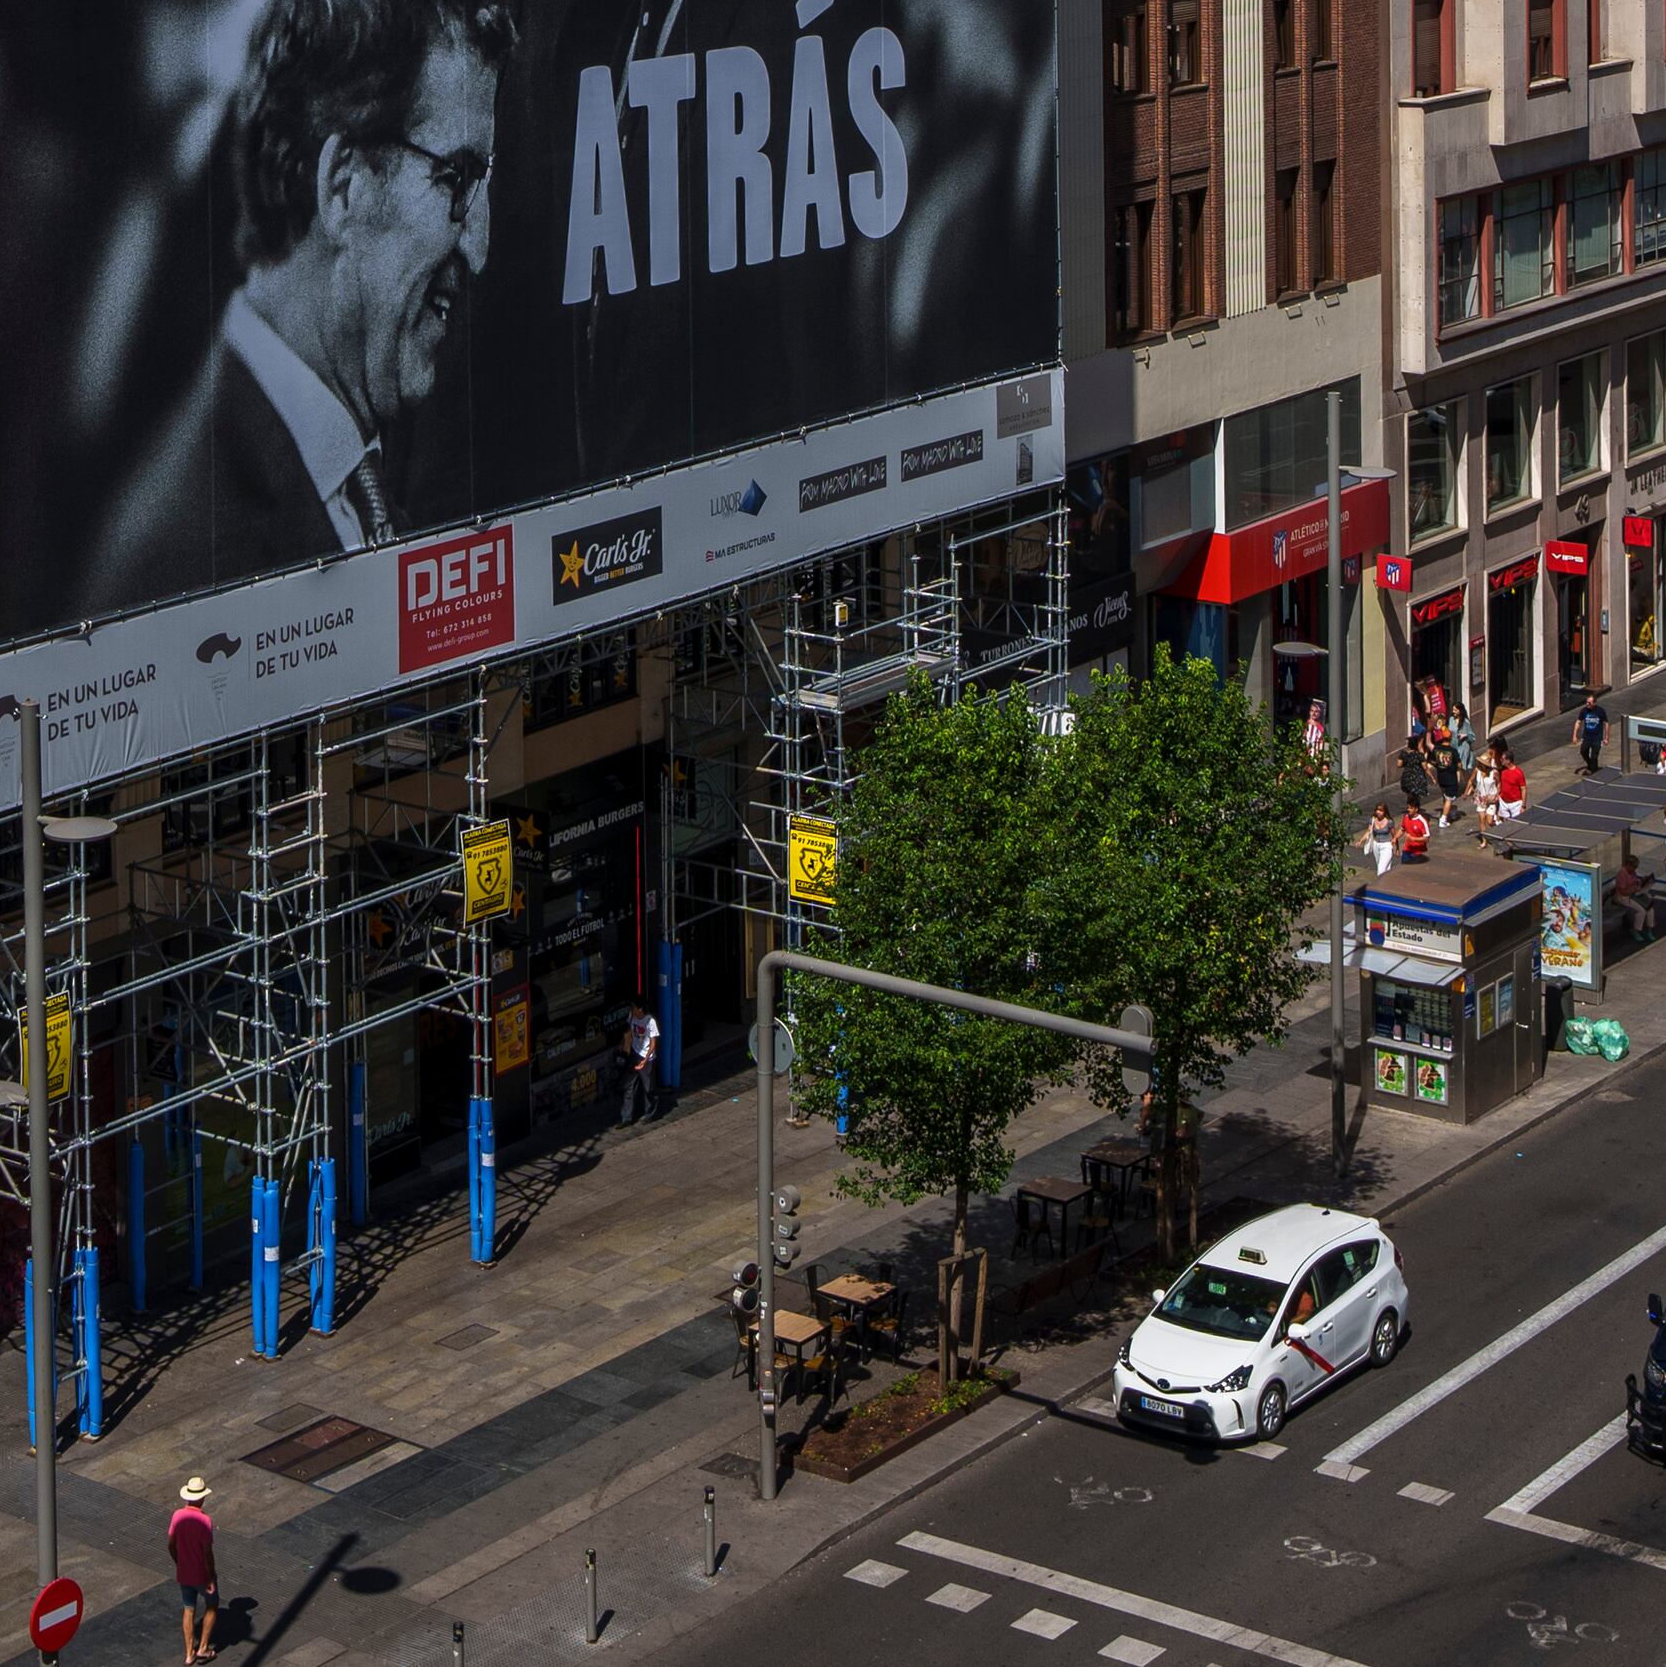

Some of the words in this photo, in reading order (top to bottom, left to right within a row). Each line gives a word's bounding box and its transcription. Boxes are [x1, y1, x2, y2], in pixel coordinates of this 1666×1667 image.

[710, 492, 741, 517] LUXOR
[800, 482, 819, 508] FROM
[821, 472, 848, 503] MADRID
[1290, 521, 1319, 542] ATLÉTICO
[1325, 510, 1350, 530] MRID
[584, 536, 627, 576] Carl's
[727, 532, 776, 556] ESTRUCTURAS
[1551, 551, 1584, 563] VIPS
[407, 538, 506, 612] DEFI
[1490, 559, 1538, 590] VIPS
[412, 605, 451, 623] FLYING
[455, 590, 503, 612] COLOURS
[1093, 590, 1132, 628] Vicens
[1411, 589, 1464, 624] VIPS
[256, 631, 277, 651] EN
[280, 624, 302, 645] UN
[305, 607, 355, 637] LUGAR
[255, 659, 277, 679] DE
[280, 650, 301, 670] TU
[303, 639, 338, 663] VIDA
[47, 692, 70, 713] EN
[74, 684, 98, 705] UN
[102, 664, 157, 696] LUGAR
[48, 721, 70, 742] DE
[74, 713, 97, 732] TU
[100, 698, 139, 725] VIDA
[548, 819, 596, 848] LIFORNIA
[597, 801, 644, 828] BURGERS
[1391, 916, 1435, 935] Apuestas
[1391, 930, 1423, 943] Estado
